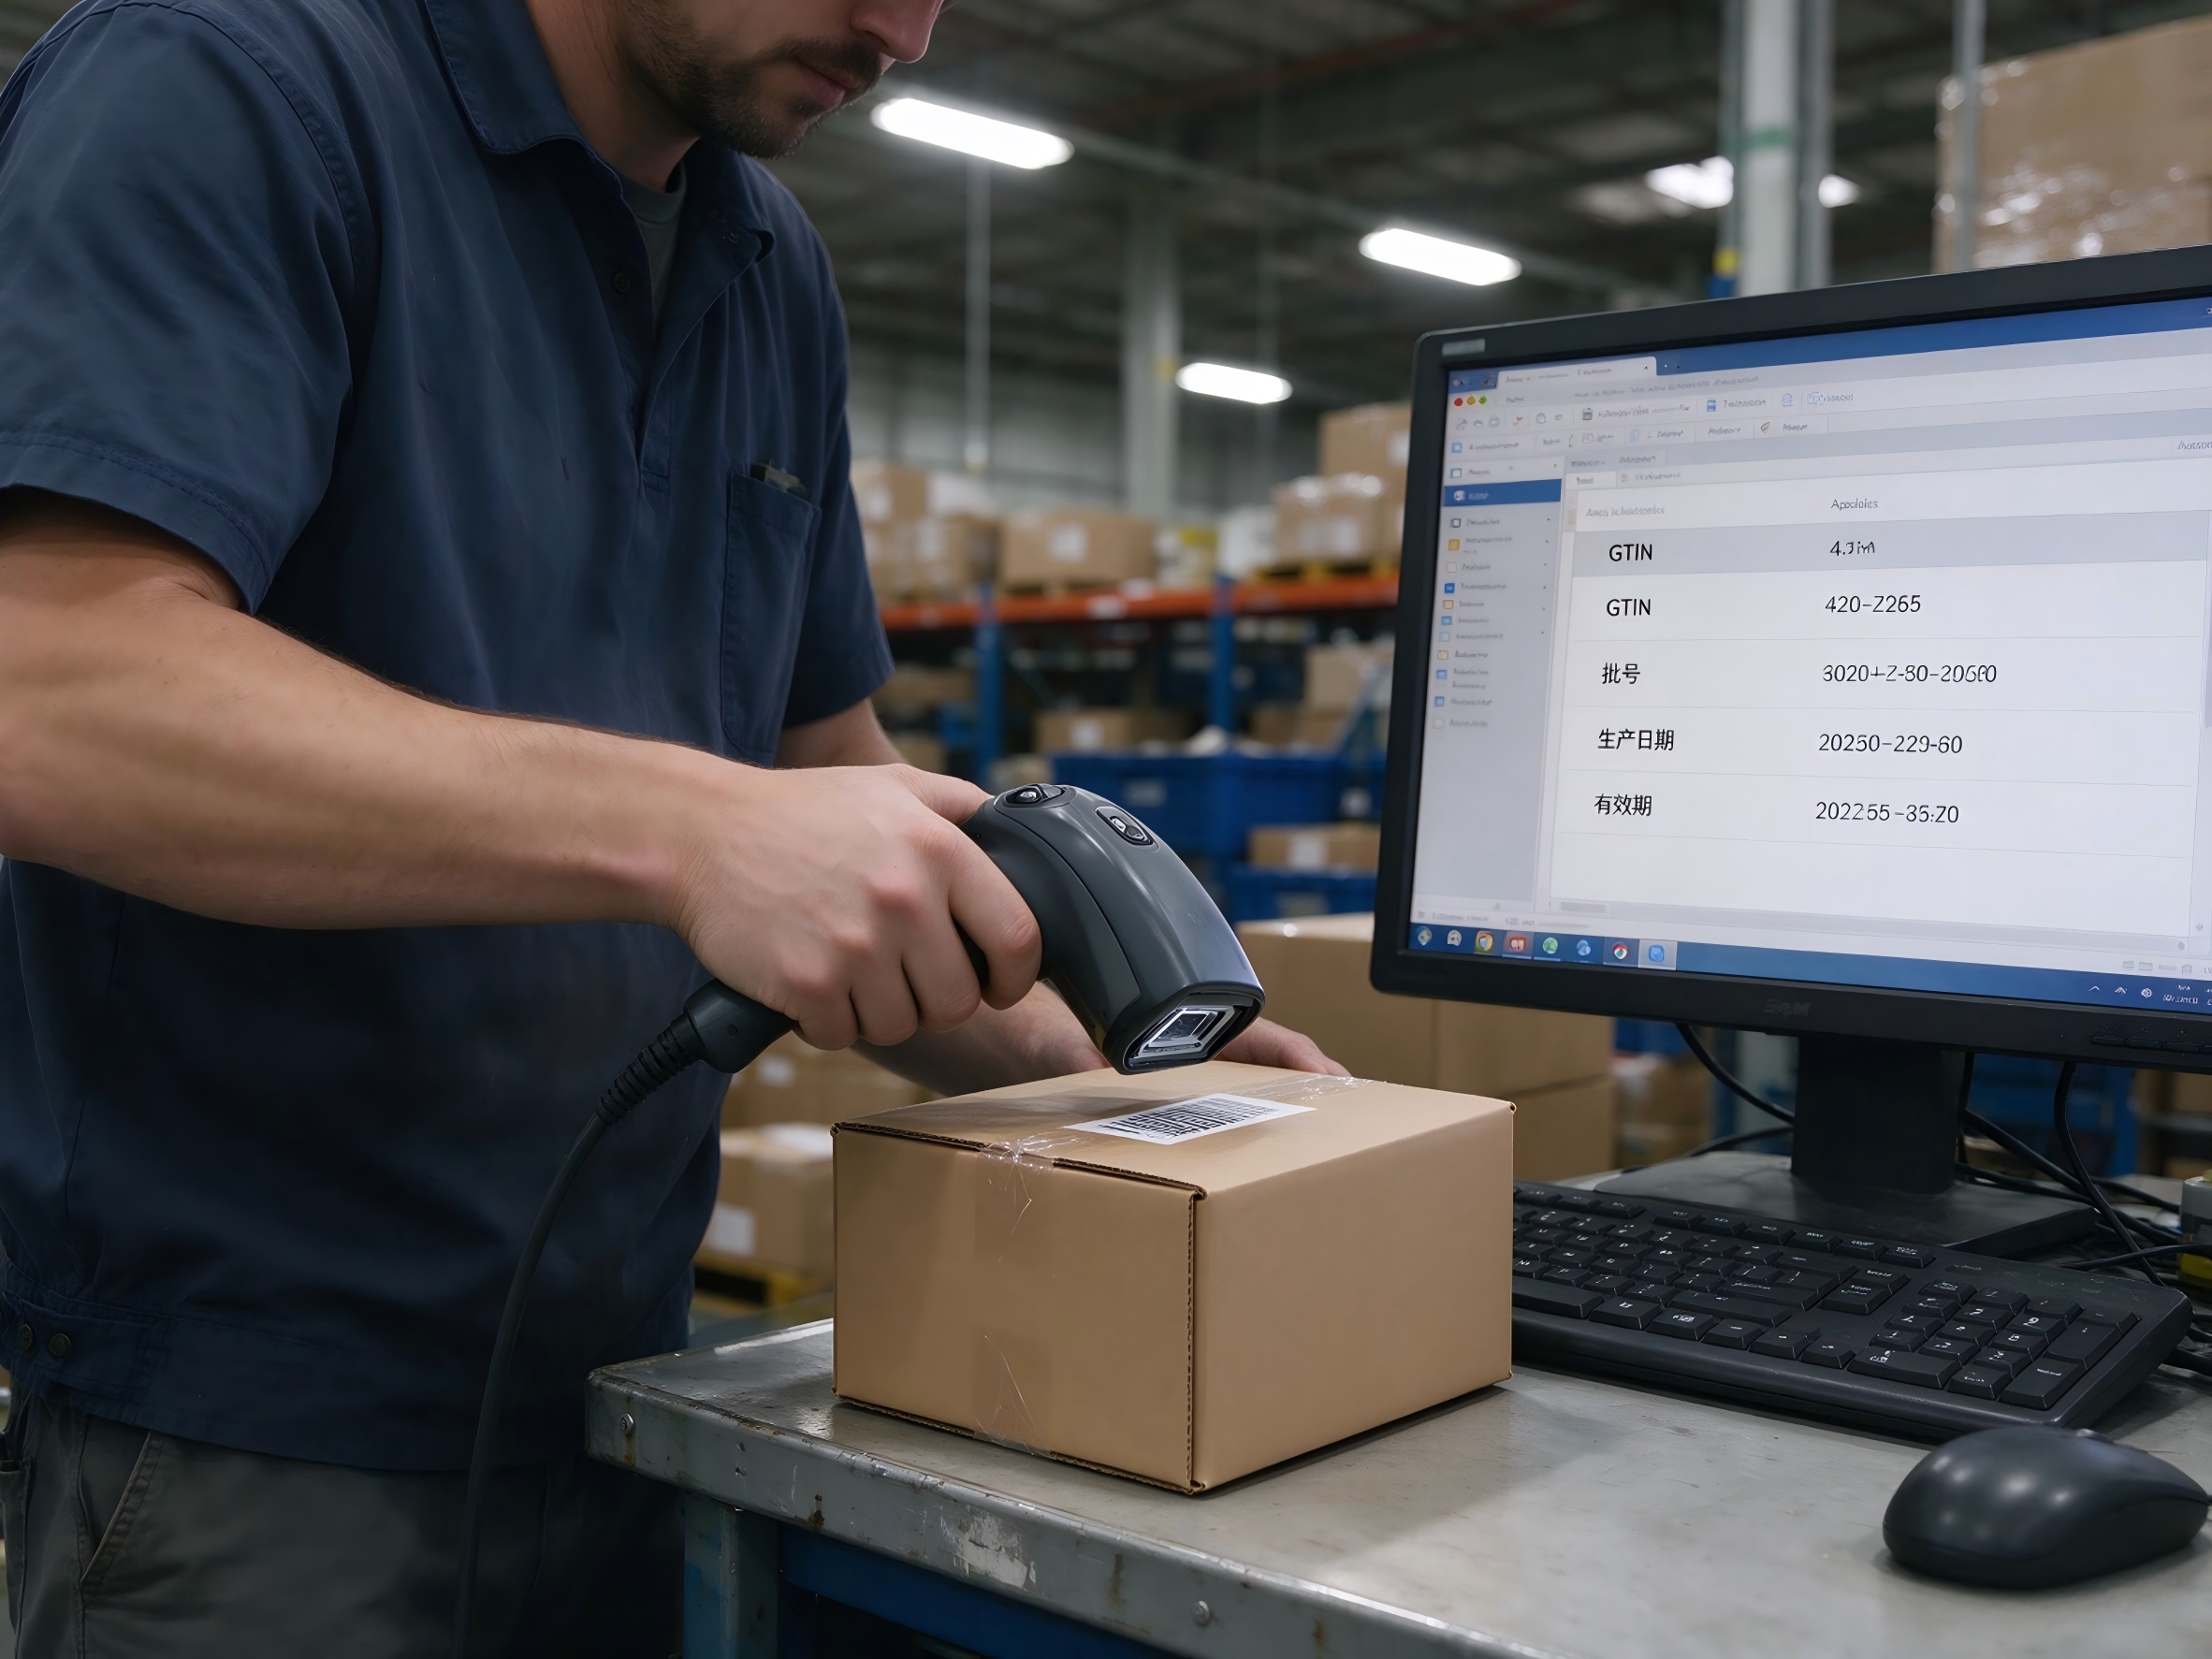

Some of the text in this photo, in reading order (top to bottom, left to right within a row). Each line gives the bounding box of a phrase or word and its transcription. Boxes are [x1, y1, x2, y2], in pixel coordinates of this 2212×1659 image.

[1608, 543, 1653, 562] GTIN
[1606, 598, 1652, 618] GTIN
[1601, 662, 1641, 685] 批号
[1597, 727, 1675, 751] 生产日期
[1594, 793, 1652, 817] 有效期
